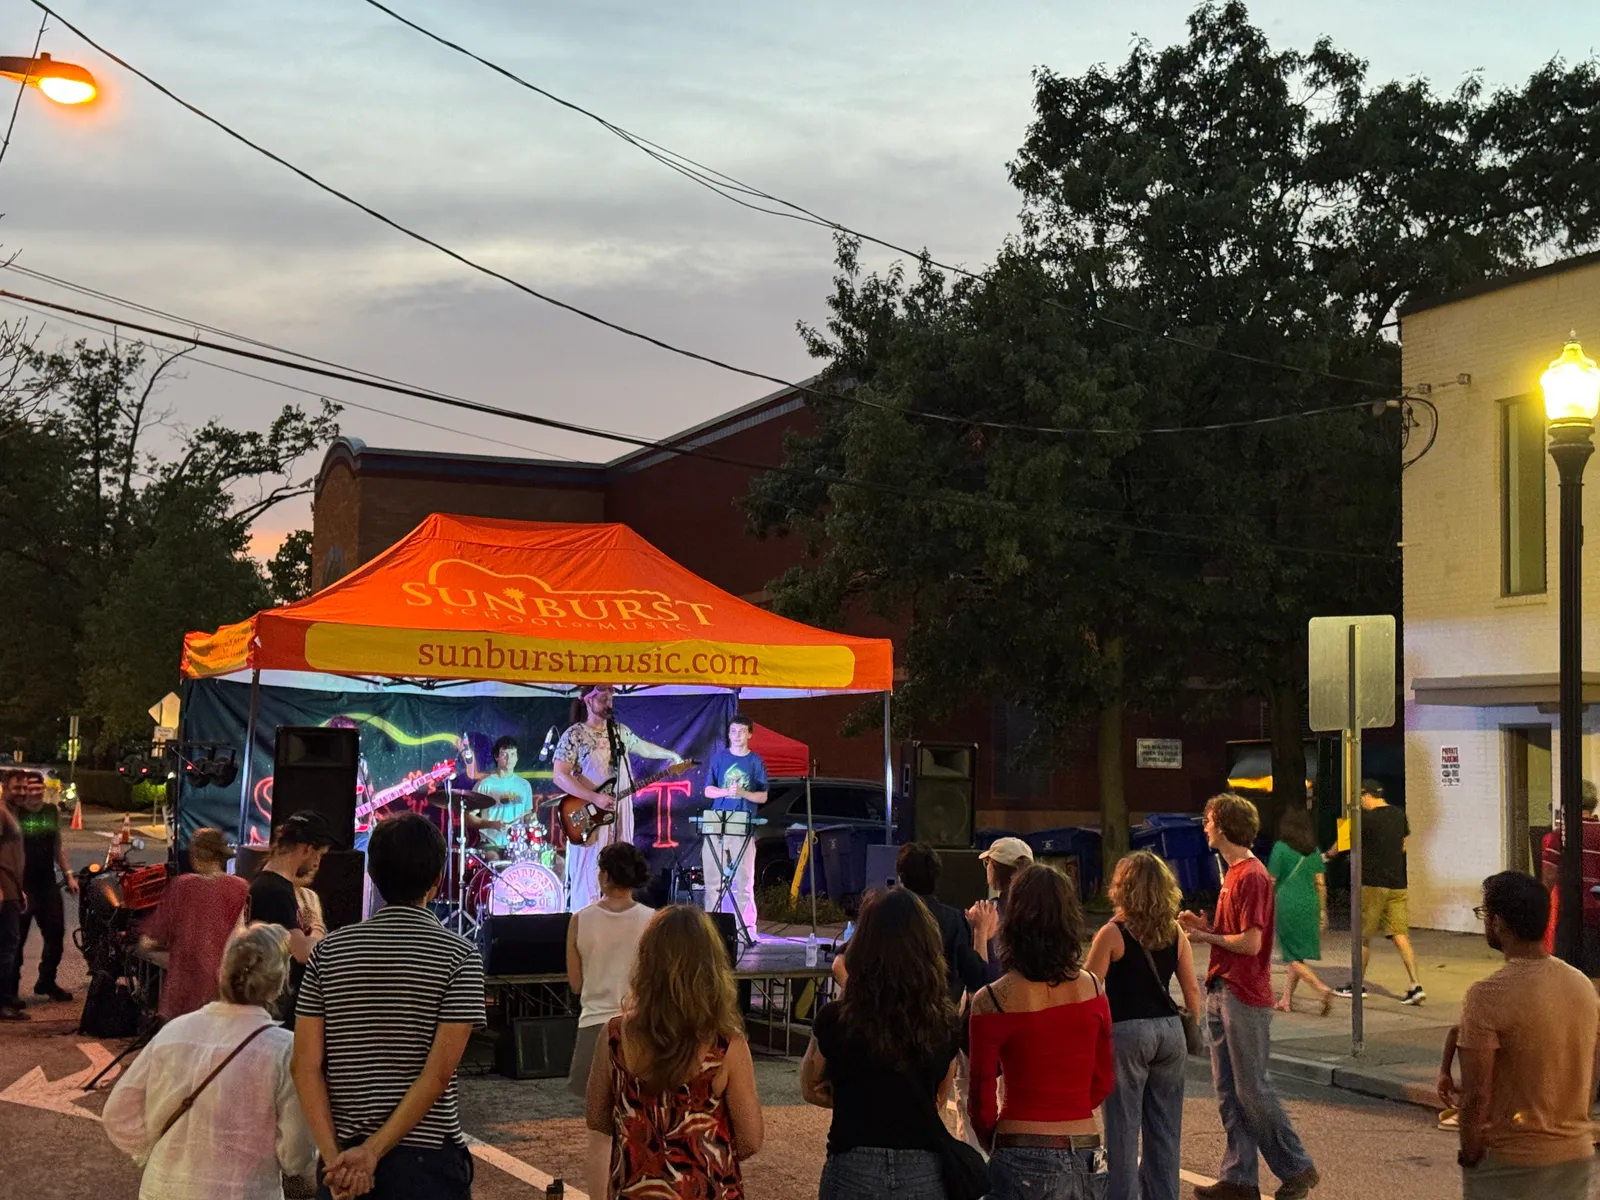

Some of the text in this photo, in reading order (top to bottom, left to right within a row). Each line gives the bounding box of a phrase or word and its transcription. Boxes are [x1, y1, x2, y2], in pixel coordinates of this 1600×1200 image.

[401, 582, 714, 626] SUNBURST
[443, 607, 568, 628] SCHOOL
[599, 621, 692, 632] MUSIC
[418, 638, 759, 676] sunburstmusic.com
